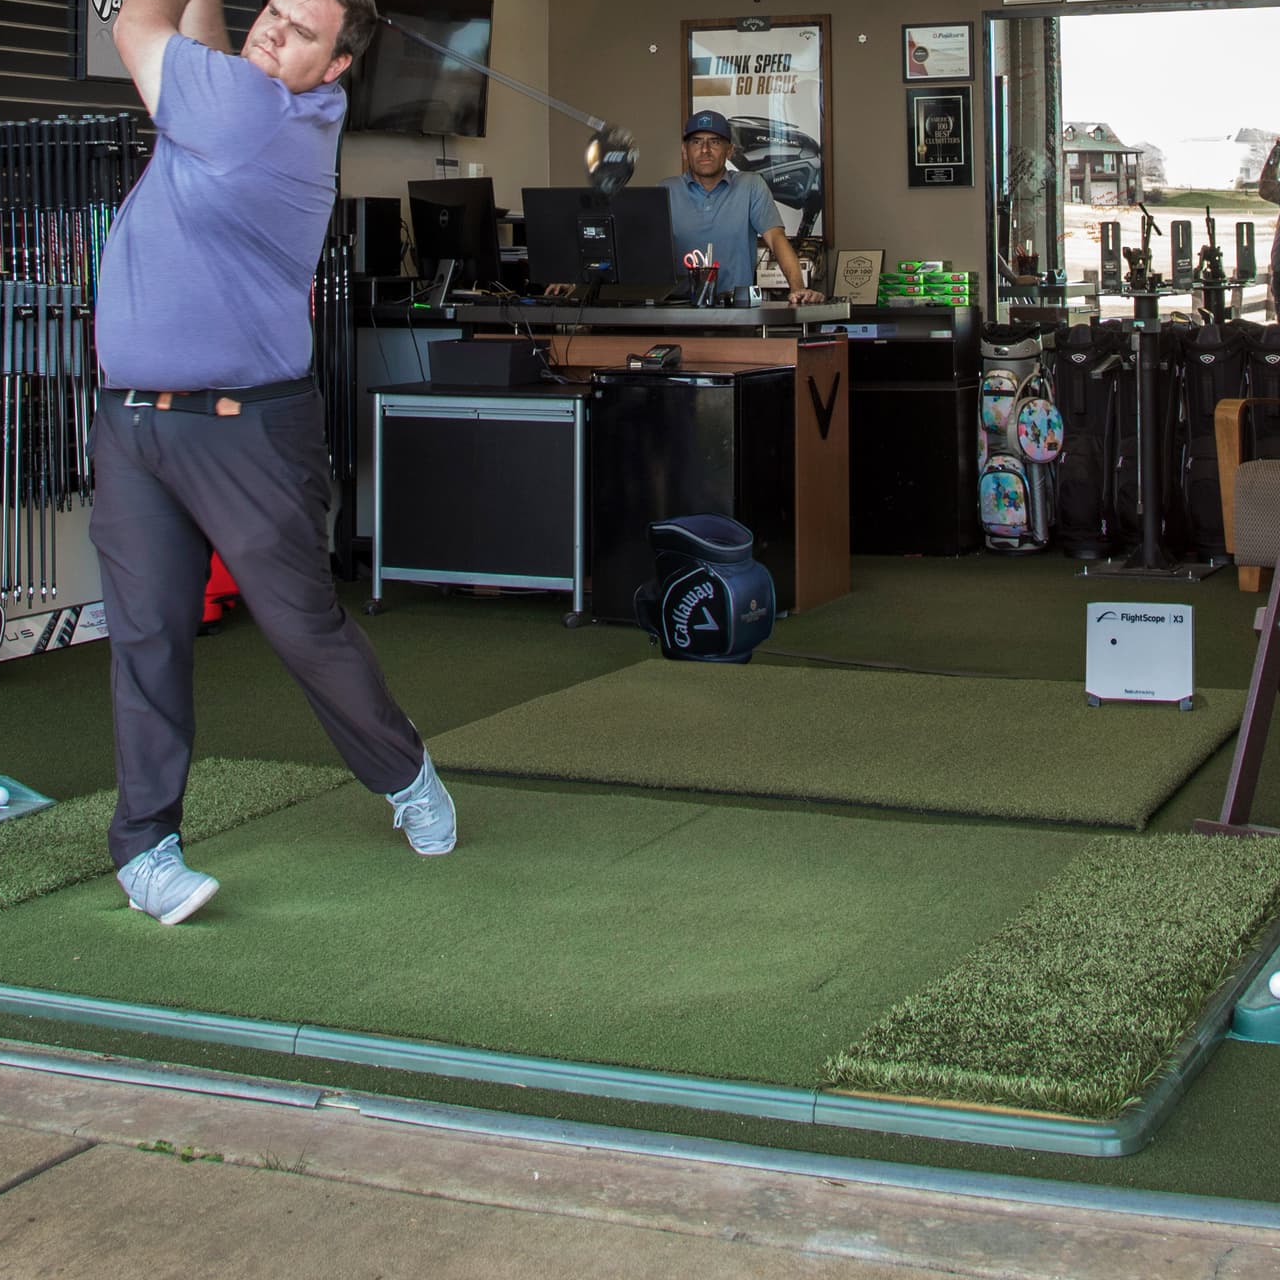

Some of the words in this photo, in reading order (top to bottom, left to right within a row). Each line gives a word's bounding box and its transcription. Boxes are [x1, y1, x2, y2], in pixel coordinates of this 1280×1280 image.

[715, 54, 752, 76] THINK
[754, 53, 793, 75] SPEED
[736, 75, 753, 96] GO
[756, 74, 799, 96] ROGUE
[674, 581, 715, 648] Callaway
[1120, 612, 1166, 624] FlightScope
[1172, 614, 1184, 624] X3
